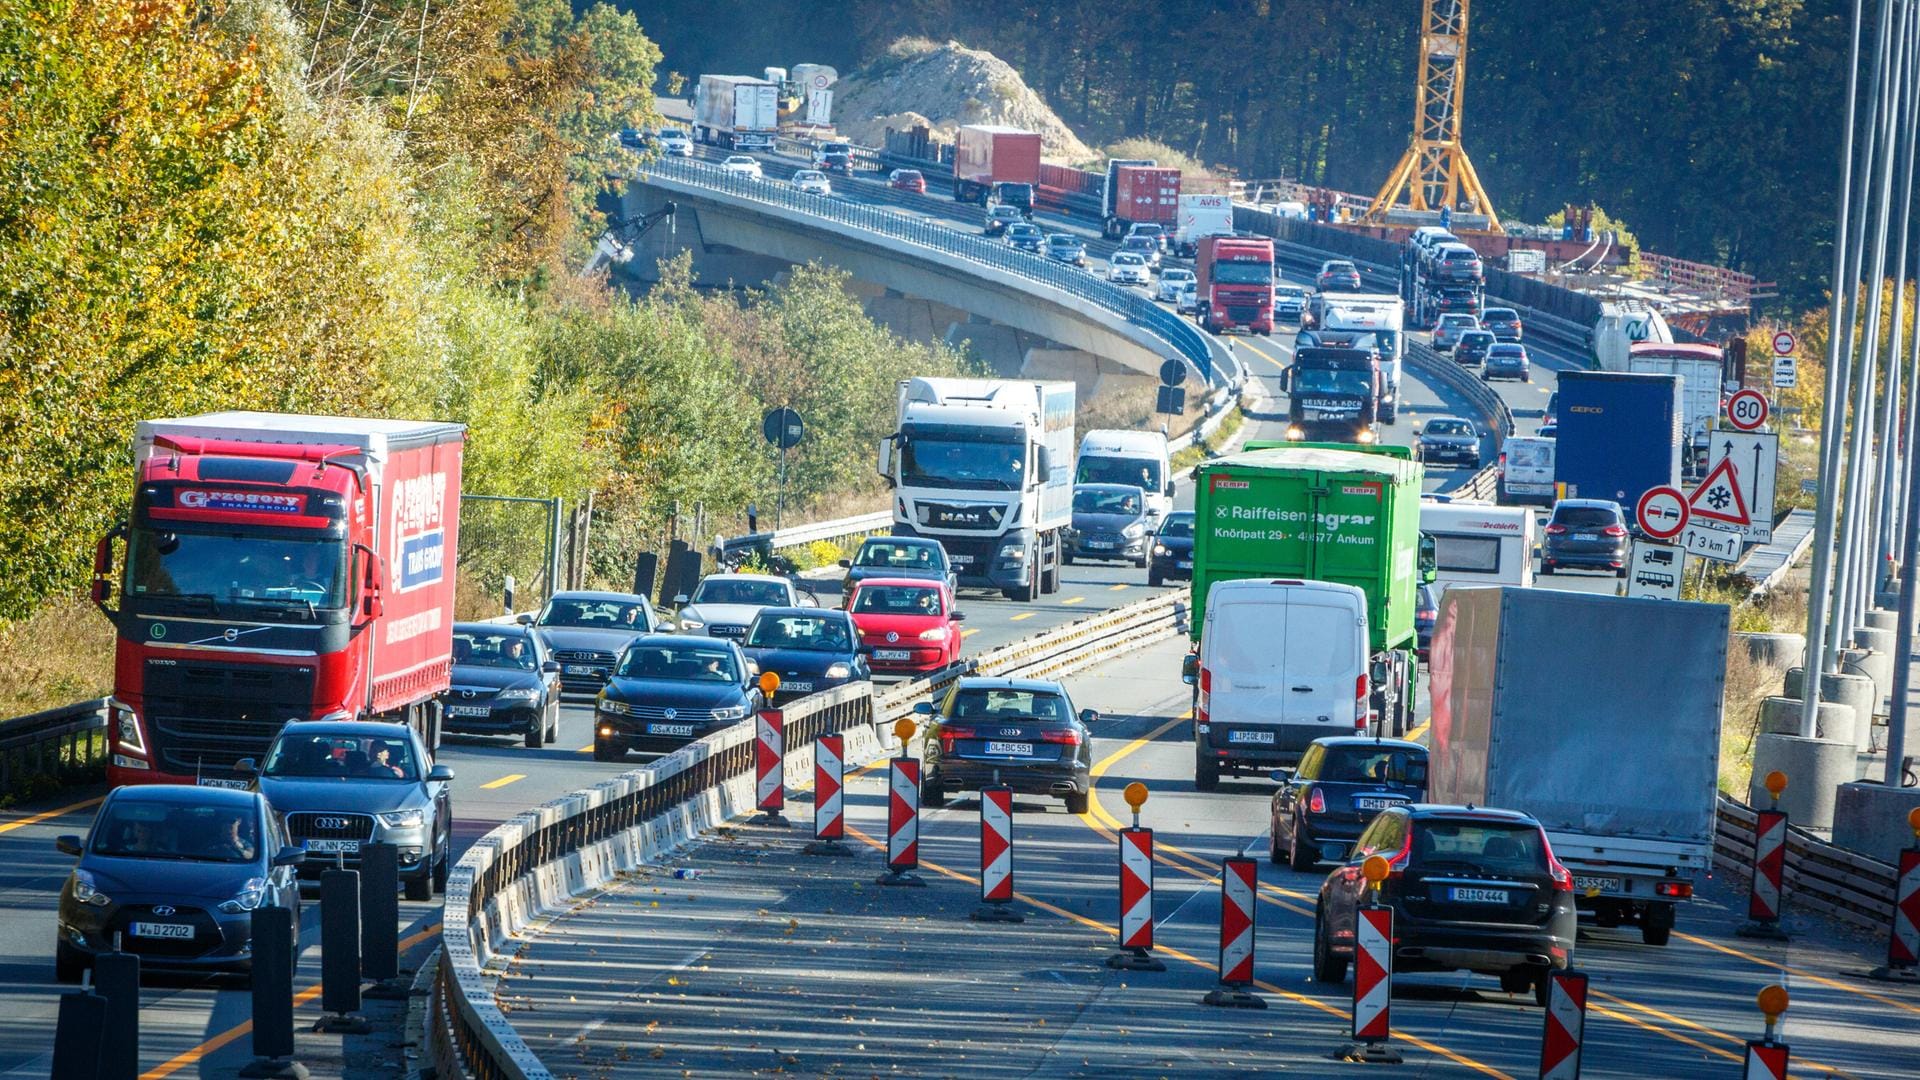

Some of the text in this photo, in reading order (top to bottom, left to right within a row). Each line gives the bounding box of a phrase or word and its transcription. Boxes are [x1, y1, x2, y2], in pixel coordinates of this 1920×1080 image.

[1736, 400, 1759, 420] 80
[179, 490, 300, 508] Grzegory
[940, 512, 979, 521] MAN
[1232, 505, 1375, 531] Raiffeisen agrar
[1215, 527, 1265, 540] Knörlpatt
[1336, 533, 1374, 544] Ankum
[1753, 527, 1769, 537] km
[1698, 537, 1723, 552] 3 km
[1017, 744, 1032, 753] 551
[307, 841, 358, 852] NR NN 255
[140, 924, 189, 937] W D 2702
